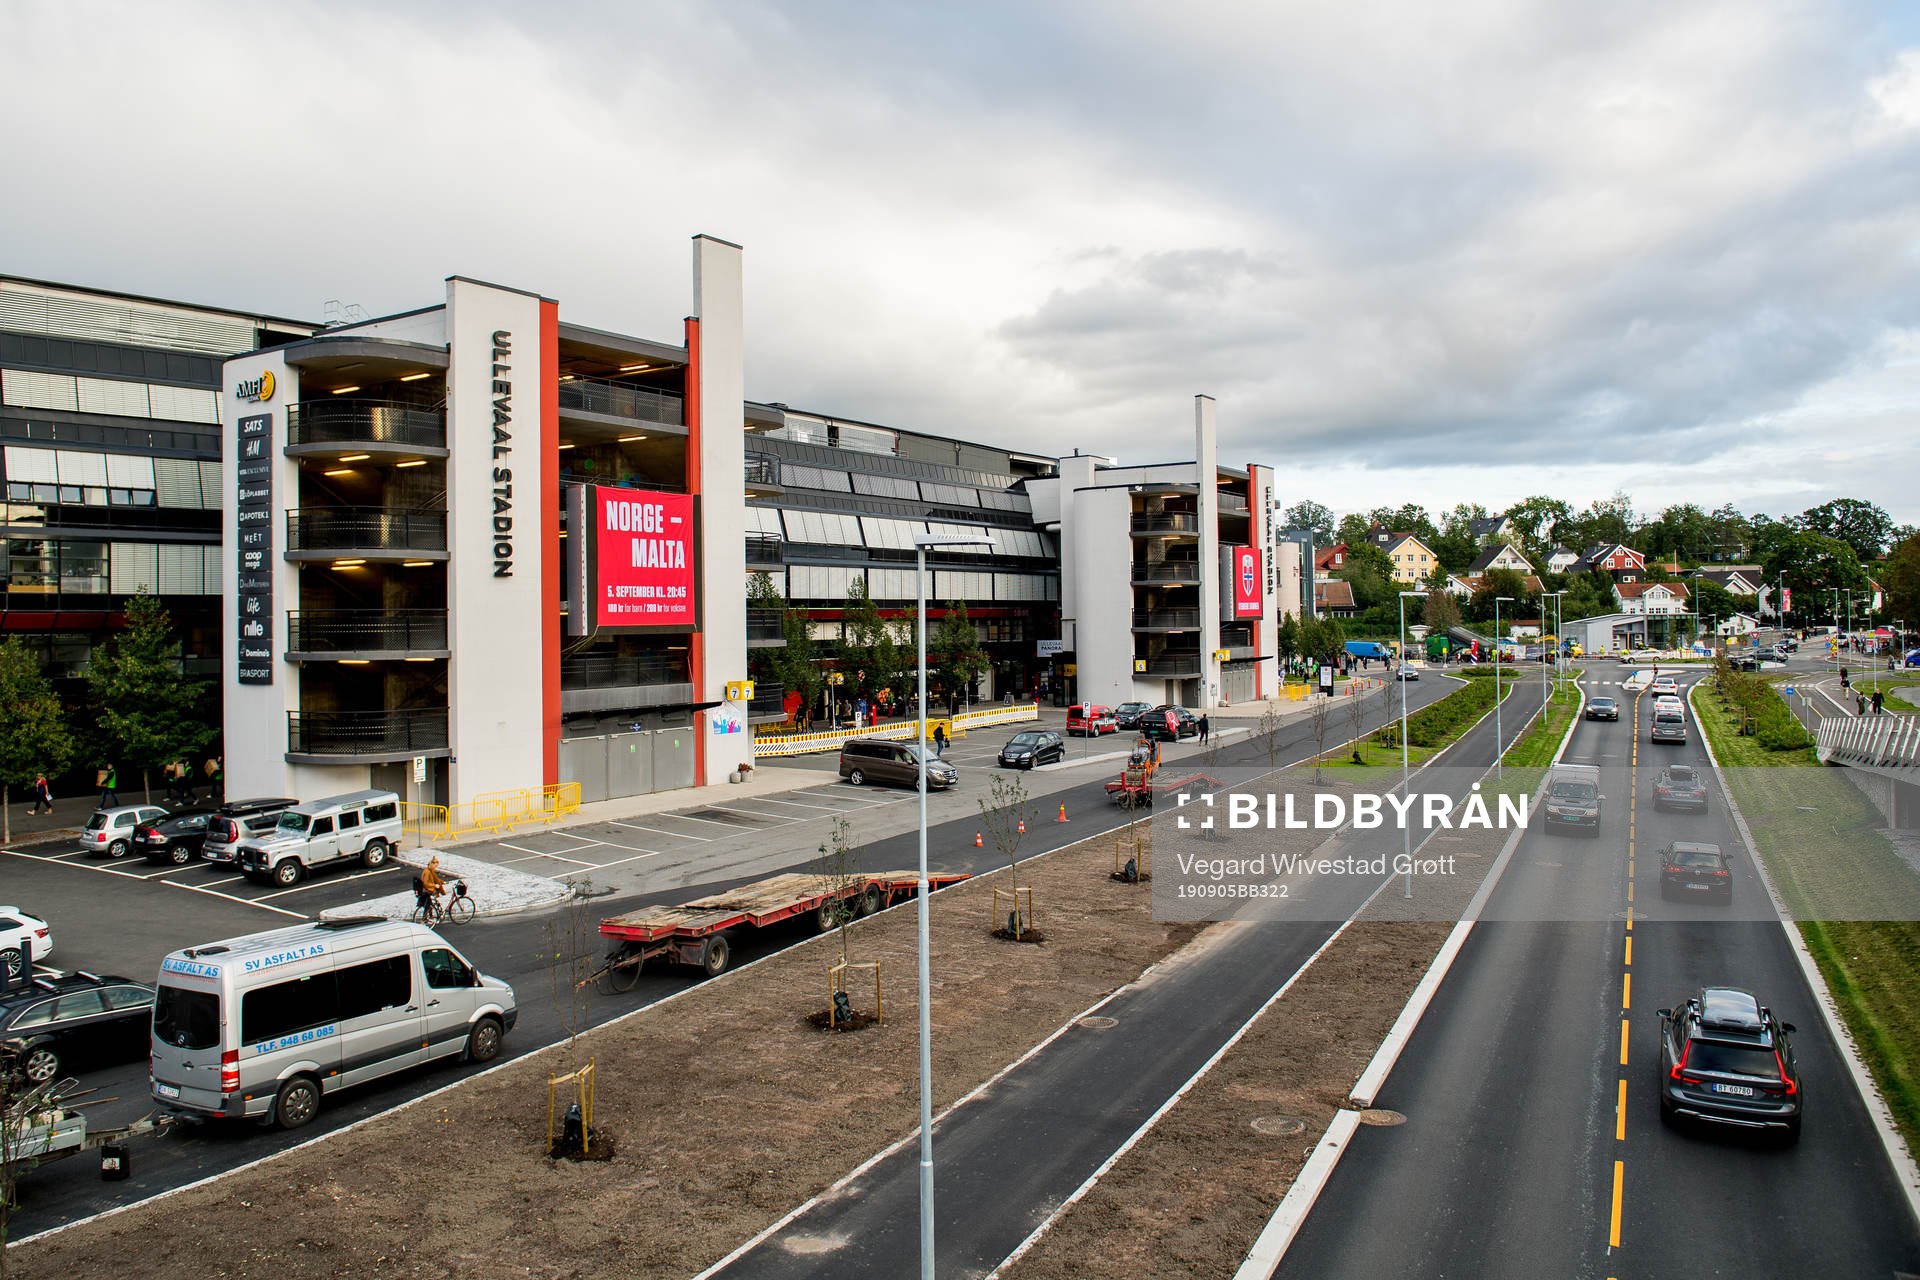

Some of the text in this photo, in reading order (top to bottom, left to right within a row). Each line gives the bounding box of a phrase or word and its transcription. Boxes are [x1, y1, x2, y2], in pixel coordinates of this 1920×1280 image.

[236, 377, 262, 398] AMFI
[244, 419, 263, 432] SATS
[492, 329, 513, 578] ULLEVAAL STADION
[245, 512, 265, 520] APOTEK
[606, 500, 664, 533] NORGE
[245, 552, 262, 560] coop
[631, 538, 685, 569] MALTA
[607, 585, 687, 598] 5. SEPTEMBER KL. 20:45
[247, 597, 260, 614] life
[244, 620, 263, 636] nille
[245, 649, 270, 657] Domino's
[416, 758, 423, 768] P
[245, 960, 260, 971] SV
[264, 948, 306, 966] ASFALT
[310, 944, 324, 955] AS
[163, 959, 218, 977] SV ASFALT AS
[256, 1025, 334, 1054] TLF. 948 68 085
